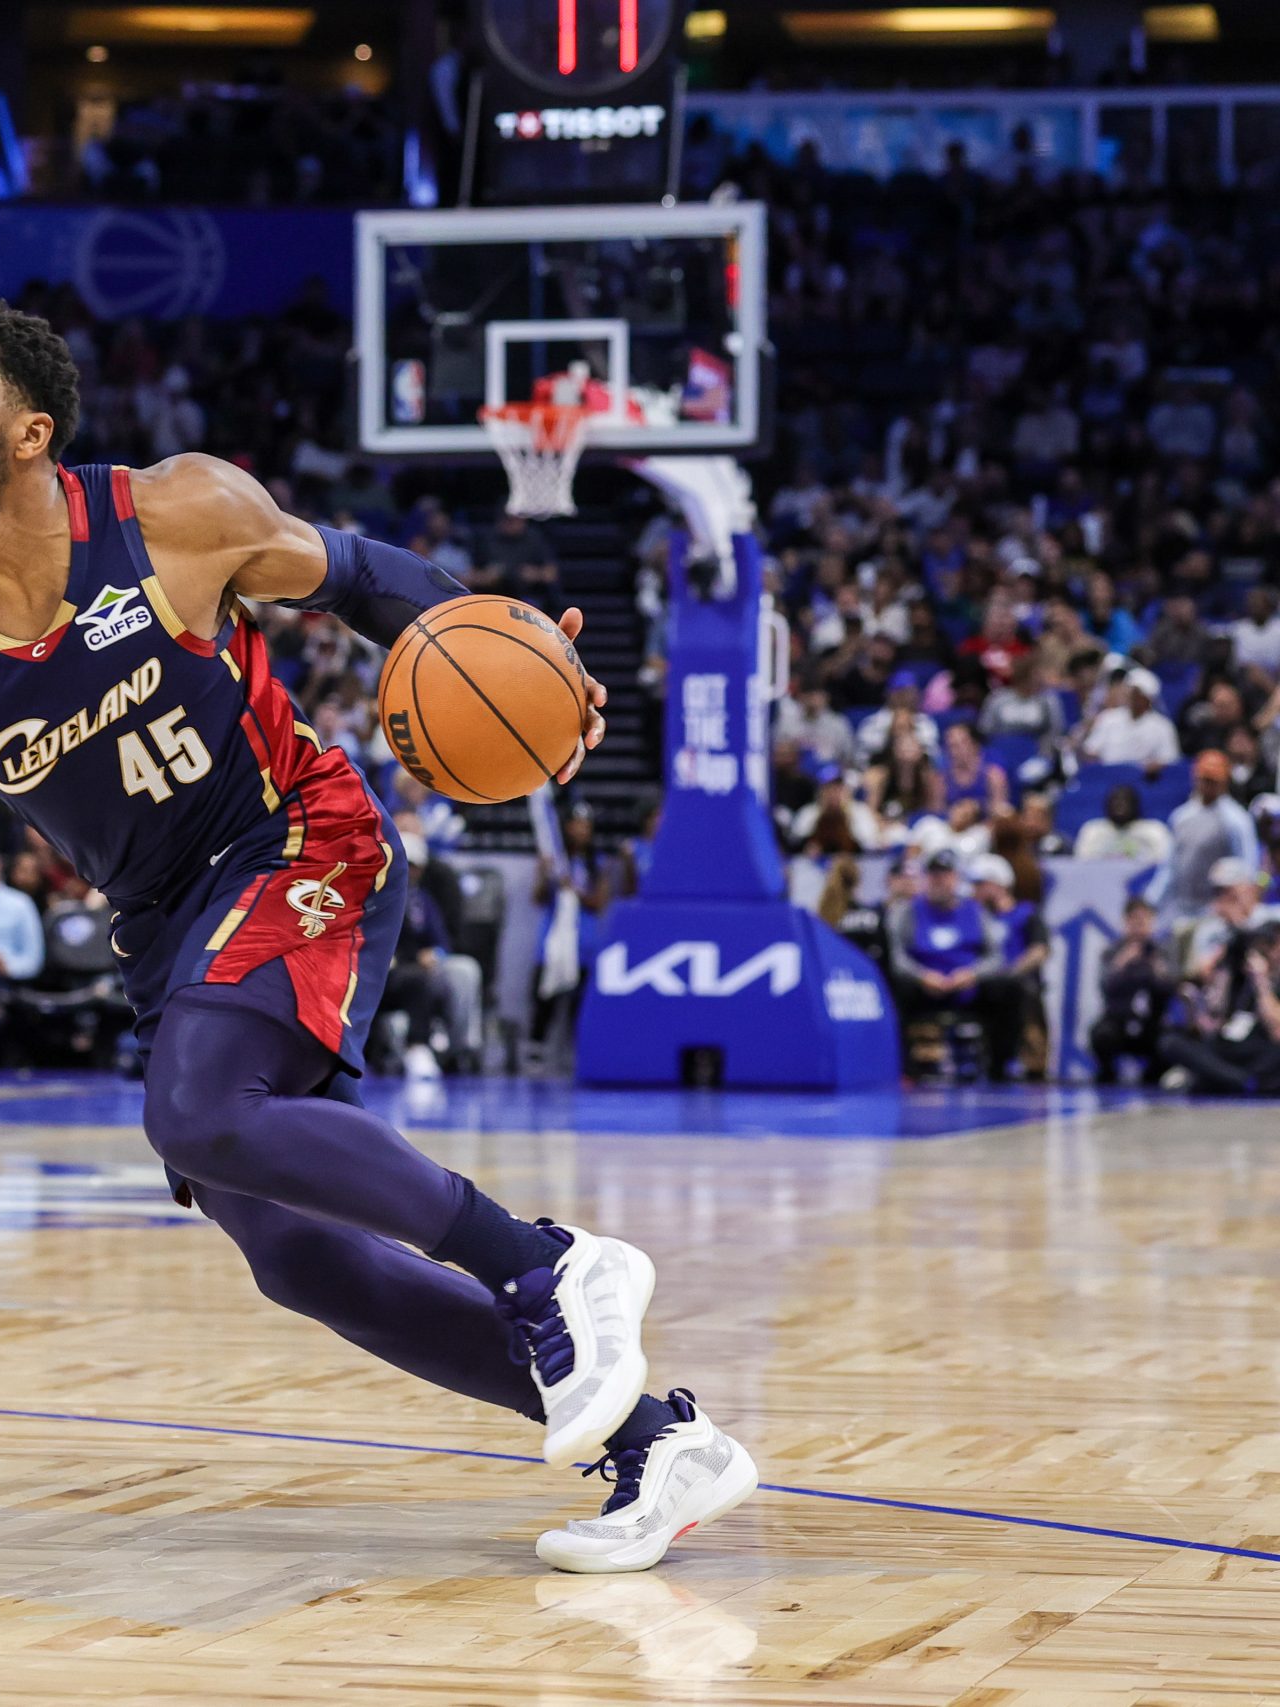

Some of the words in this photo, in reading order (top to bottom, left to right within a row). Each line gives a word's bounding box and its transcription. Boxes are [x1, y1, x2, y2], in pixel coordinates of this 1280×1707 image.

[541, 105, 666, 140] TISSOT
[87, 609, 149, 646] CLIFFS
[117, 704, 214, 805] 45
